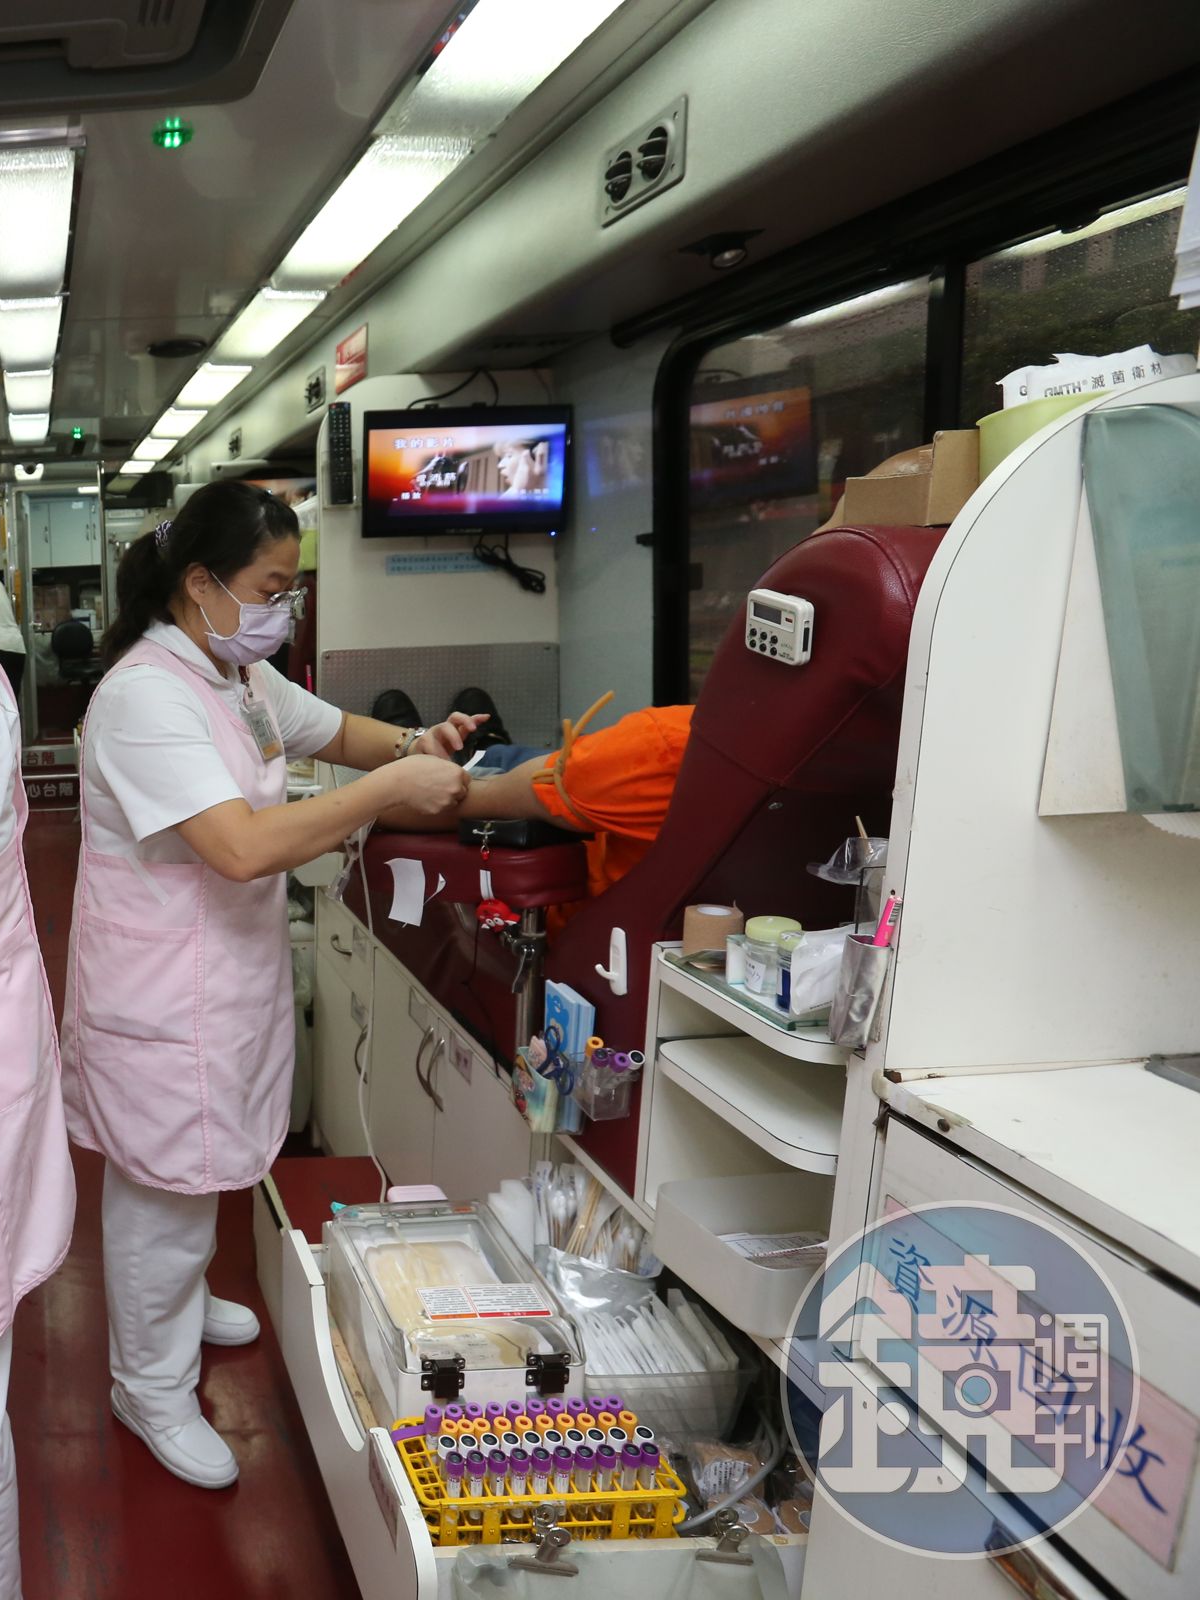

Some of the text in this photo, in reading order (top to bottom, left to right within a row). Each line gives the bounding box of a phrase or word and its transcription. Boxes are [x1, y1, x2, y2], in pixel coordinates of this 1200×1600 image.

[1091, 362, 1162, 389] 滅菌衛材
[394, 436, 455, 450] 我的影片
[887, 1236, 1169, 1517] 資源回收
